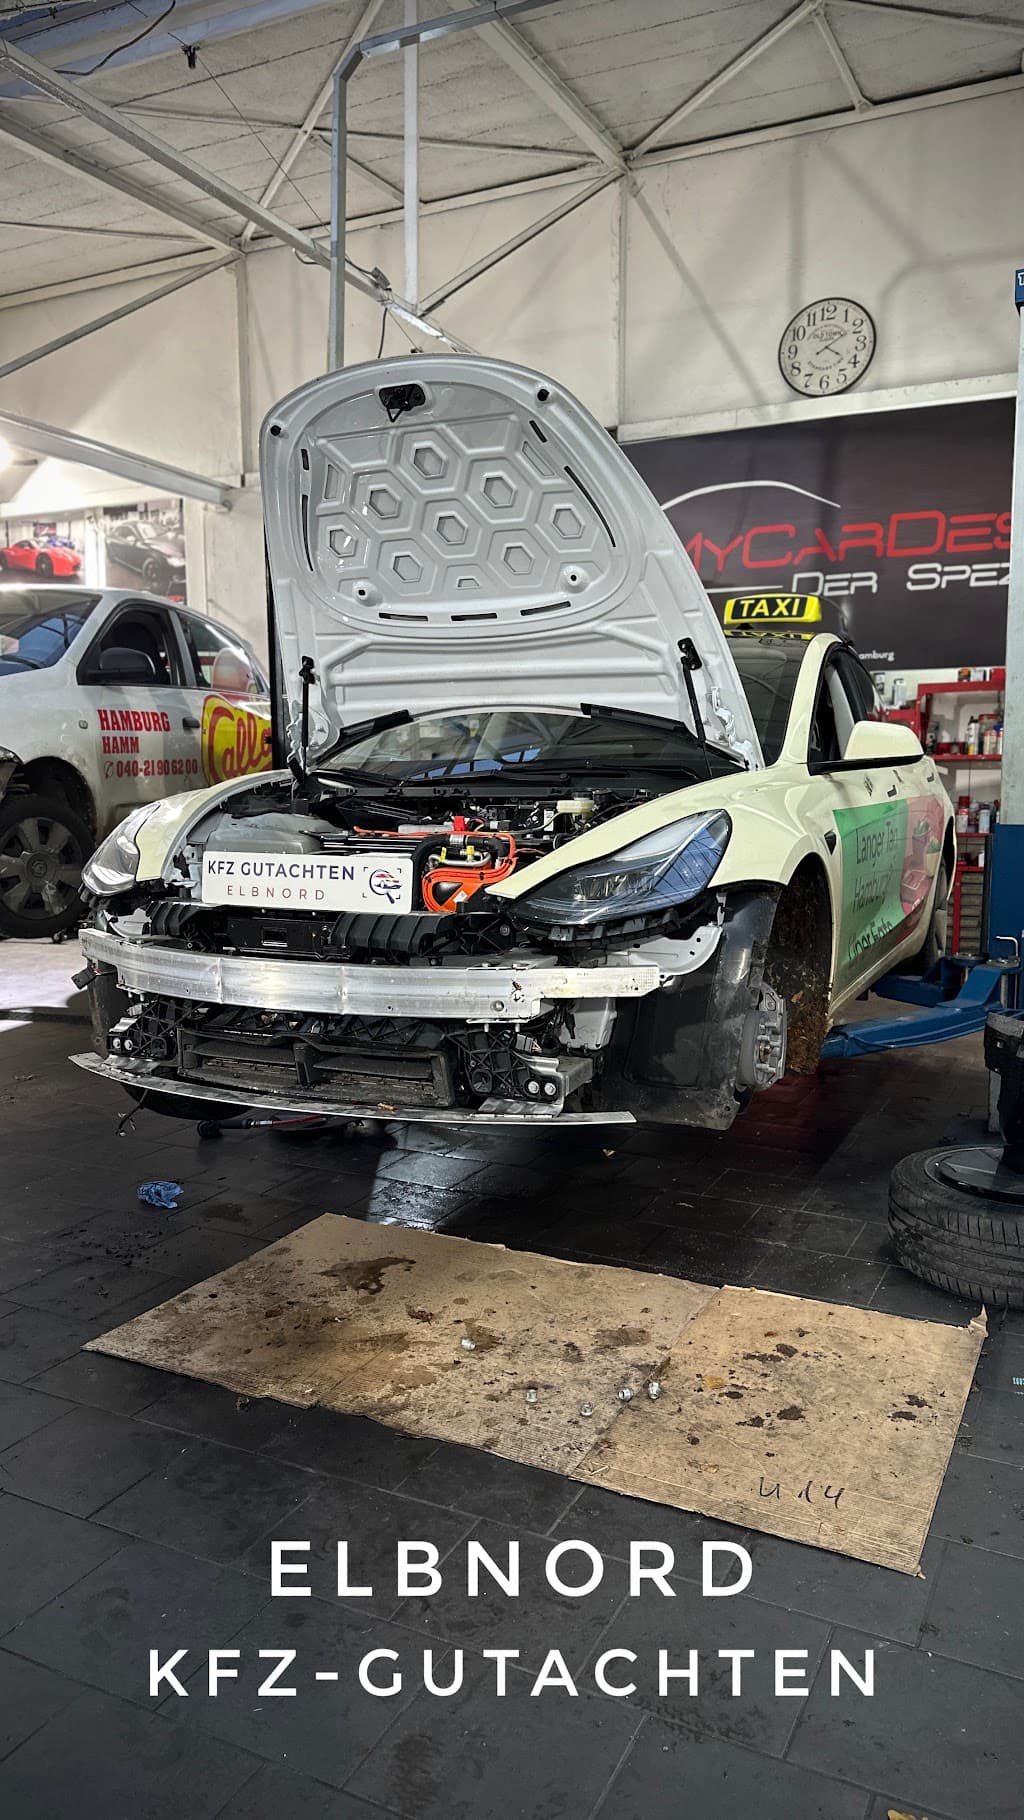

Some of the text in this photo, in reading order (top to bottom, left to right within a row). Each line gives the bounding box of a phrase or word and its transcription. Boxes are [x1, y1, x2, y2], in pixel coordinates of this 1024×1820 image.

[807, 311, 816, 327] 11
[821, 304, 837, 321] 12
[844, 308, 849, 323] 1
[792, 325, 806, 341] 10
[852, 318, 864, 334] 2
[855, 335, 867, 352] 3
[787, 345, 798, 360] 9
[790, 361, 802, 376] 8
[848, 354, 860, 368] 4
[803, 373, 813, 388] 7
[819, 375, 830, 390] 6
[836, 368, 848, 384] 5
[792, 562, 1011, 597] DER SPE
[740, 598, 801, 617] TAXI
[858, 650, 895, 662] amburg
[97, 709, 171, 733] HAMBURG
[102, 736, 140, 754] HAMM
[208, 860, 355, 881] KFZ GUTACHTEN
[227, 885, 325, 901] ELBNORD
